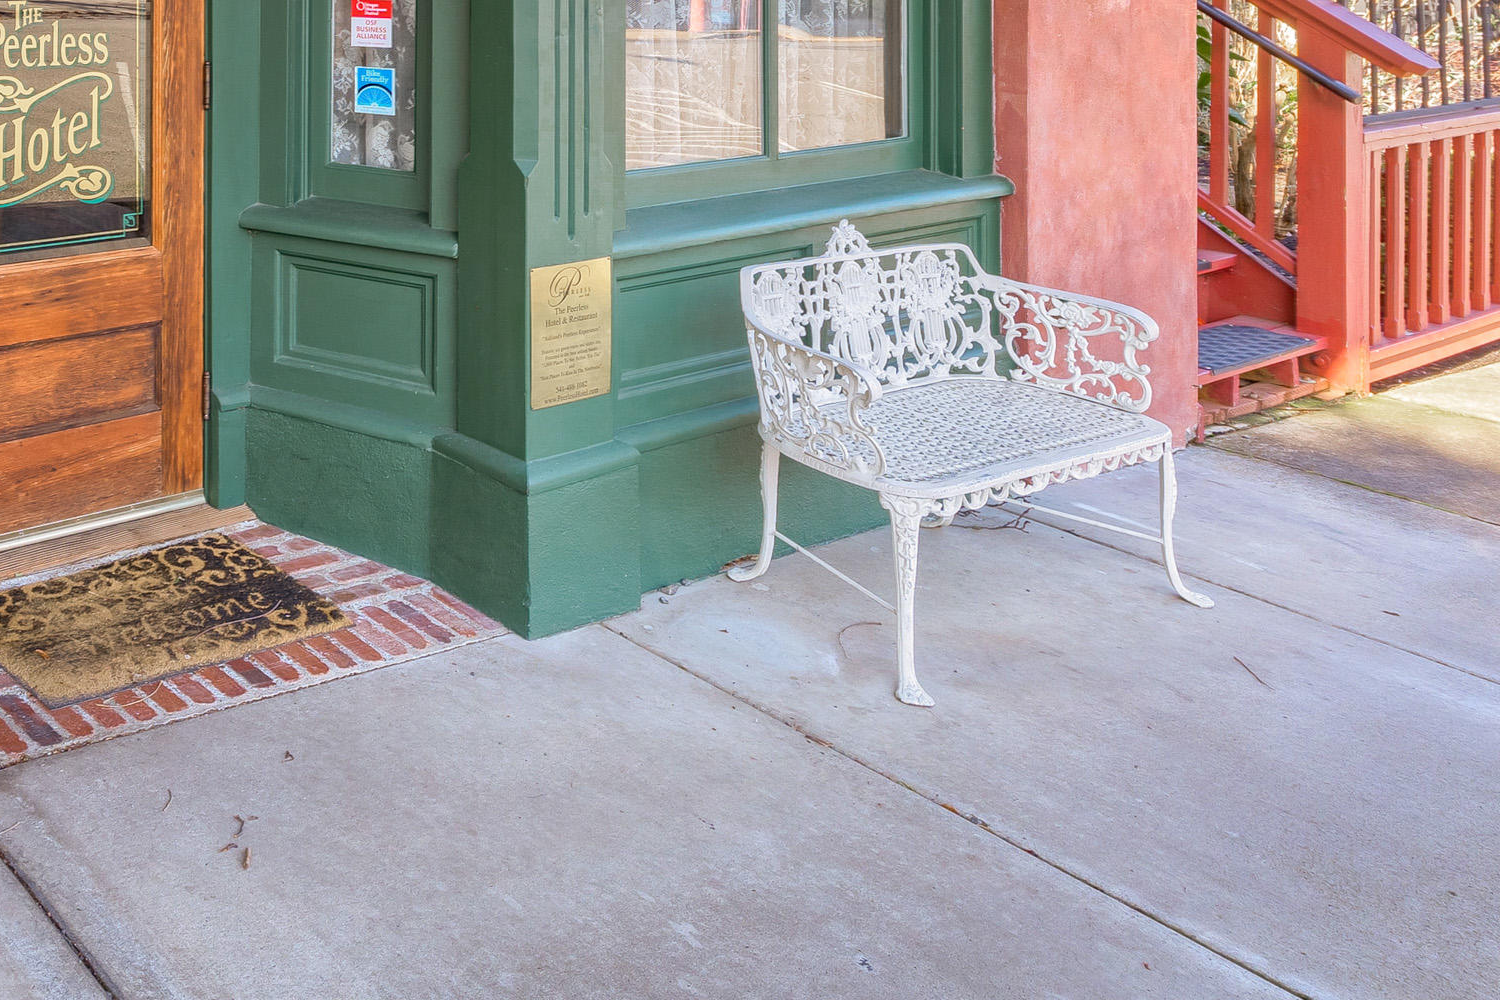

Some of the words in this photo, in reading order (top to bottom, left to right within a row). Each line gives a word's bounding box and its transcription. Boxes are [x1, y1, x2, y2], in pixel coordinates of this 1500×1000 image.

[361, 75, 389, 84] Friendly
[555, 307, 565, 316] The
[566, 304, 588, 314] Peerless
[545, 316, 561, 327] Hotel
[569, 312, 598, 323] Restaurant
